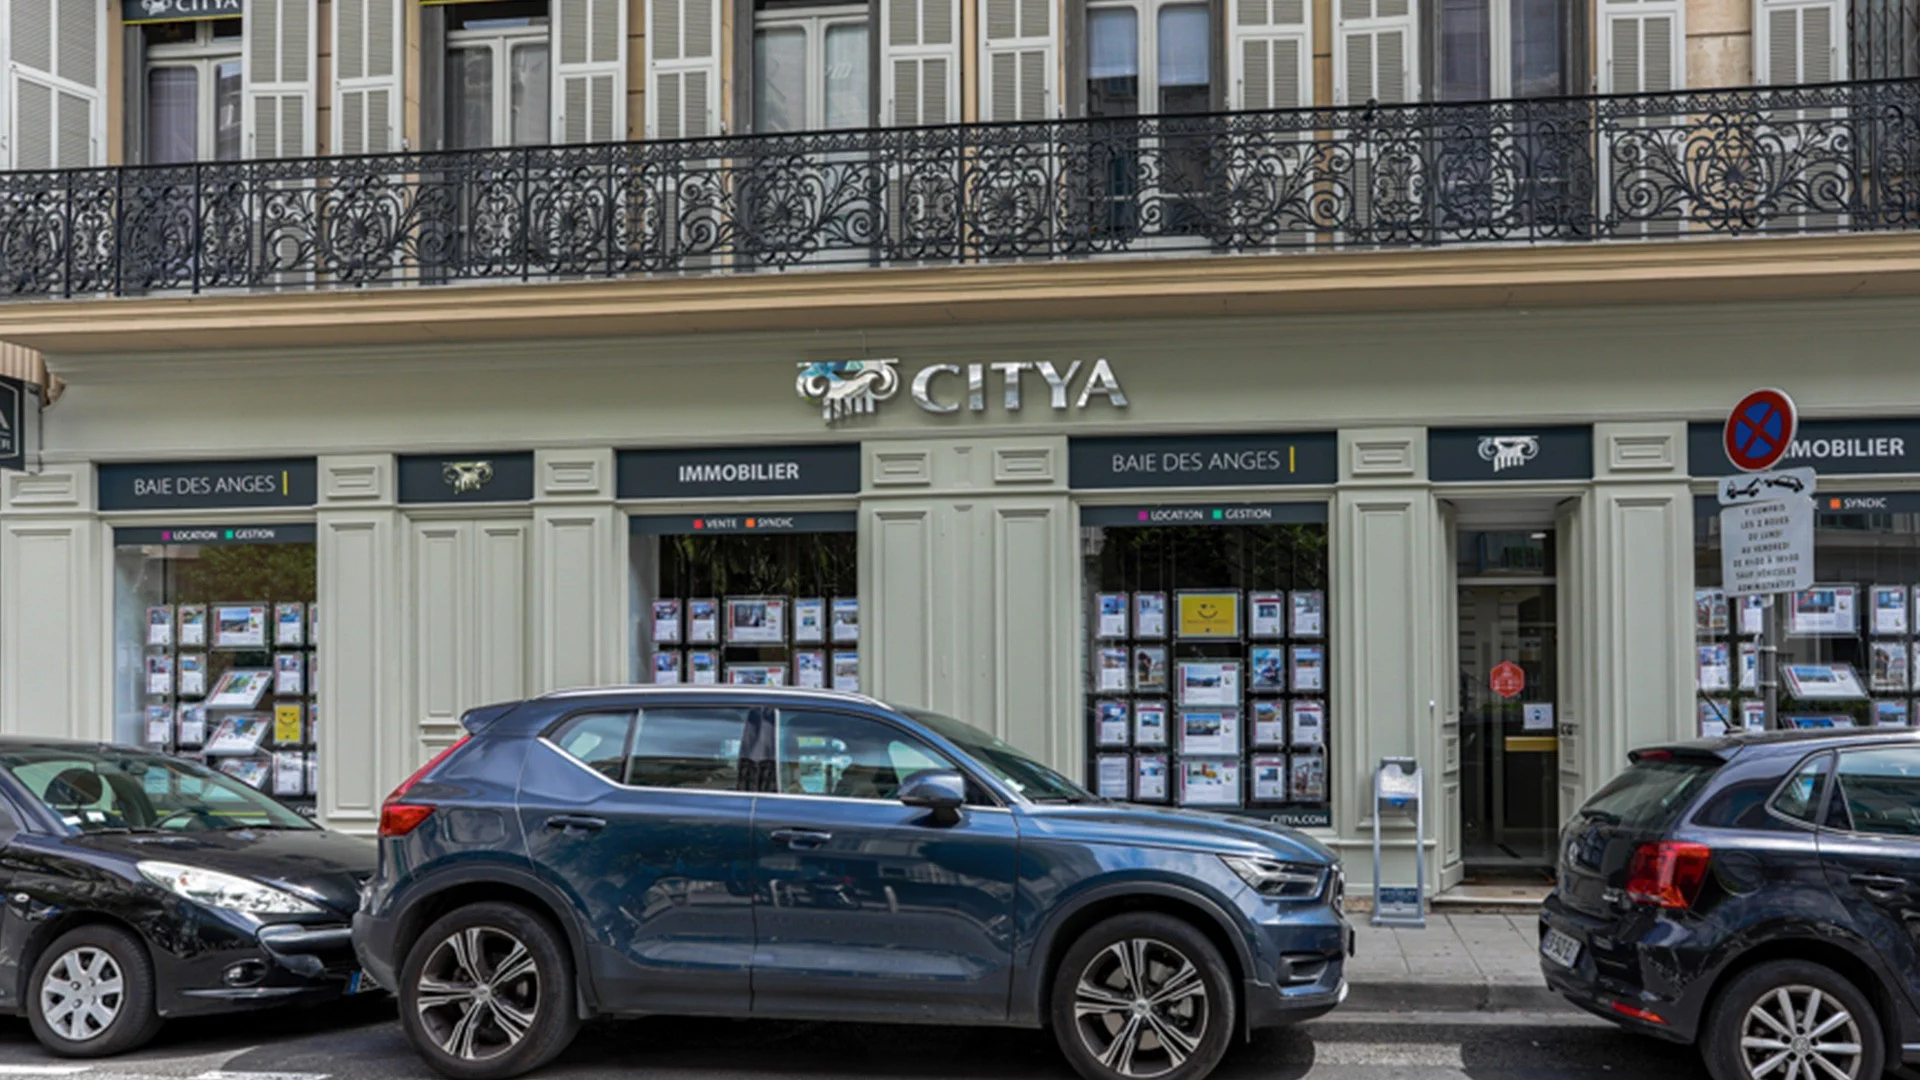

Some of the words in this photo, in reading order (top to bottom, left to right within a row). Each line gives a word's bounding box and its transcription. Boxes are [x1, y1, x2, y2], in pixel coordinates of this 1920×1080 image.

[911, 358, 1129, 413] CITYA
[1785, 438, 1905, 458] MOBILIER
[1112, 453, 1157, 472] BAIE
[1163, 452, 1203, 471] DES
[1208, 450, 1281, 470] ANGES
[678, 462, 800, 482] IMMOBILIER
[134, 478, 173, 496] BAIE
[176, 477, 211, 495] DES
[214, 475, 275, 493] ANGES
[1843, 497, 1888, 509] SYNDIC
[1150, 510, 1203, 520] LOCATION
[1225, 509, 1272, 519] GESTION
[705, 519, 737, 528] VENTE
[758, 517, 794, 528] SYNDIC
[173, 530, 218, 540] LOCATION
[235, 529, 275, 539] GESTION
[1270, 814, 1327, 824] CITYA.COM
